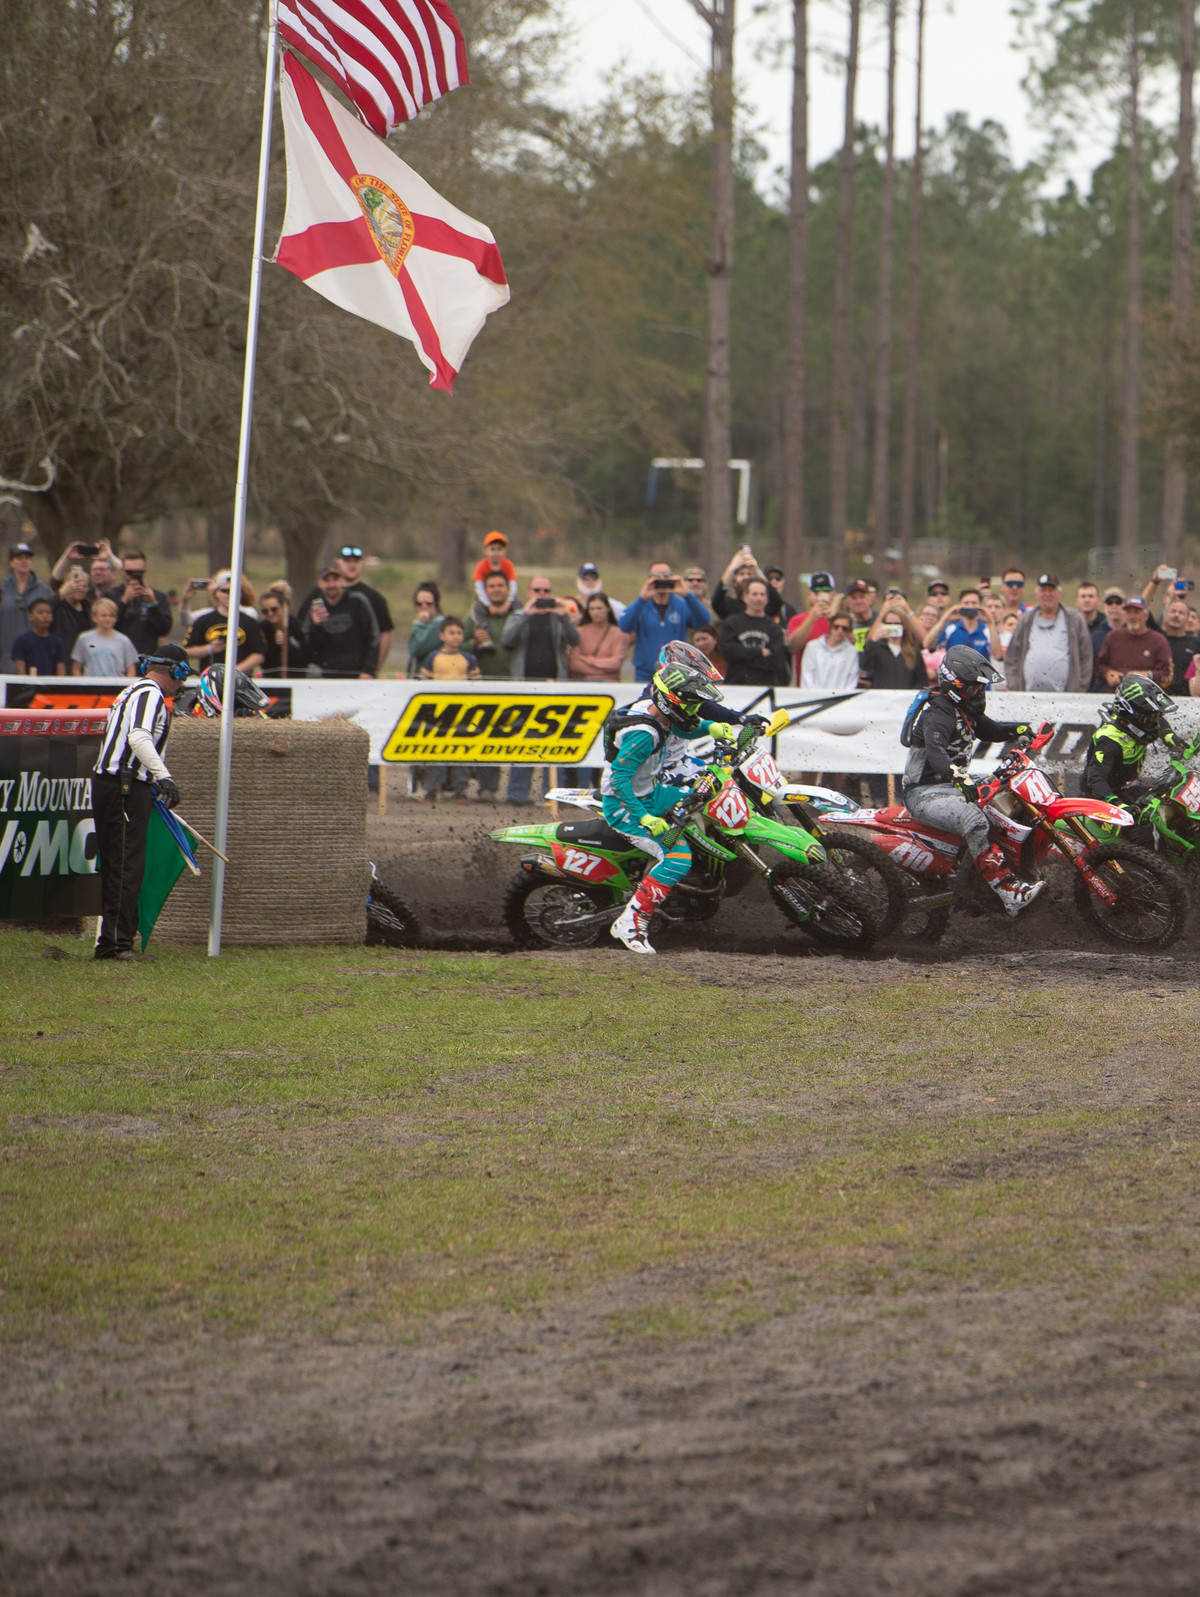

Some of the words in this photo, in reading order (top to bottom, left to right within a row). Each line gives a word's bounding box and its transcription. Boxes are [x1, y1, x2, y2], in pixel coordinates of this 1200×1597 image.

[370, 177, 388, 192] THE
[404, 703, 599, 739] MOOSE
[394, 744, 476, 755] UTILITY
[481, 745, 579, 756] DIVISION
[752, 754, 781, 789] 212
[716, 787, 748, 828] 127
[563, 849, 602, 876] 127
[888, 842, 934, 871] 410
